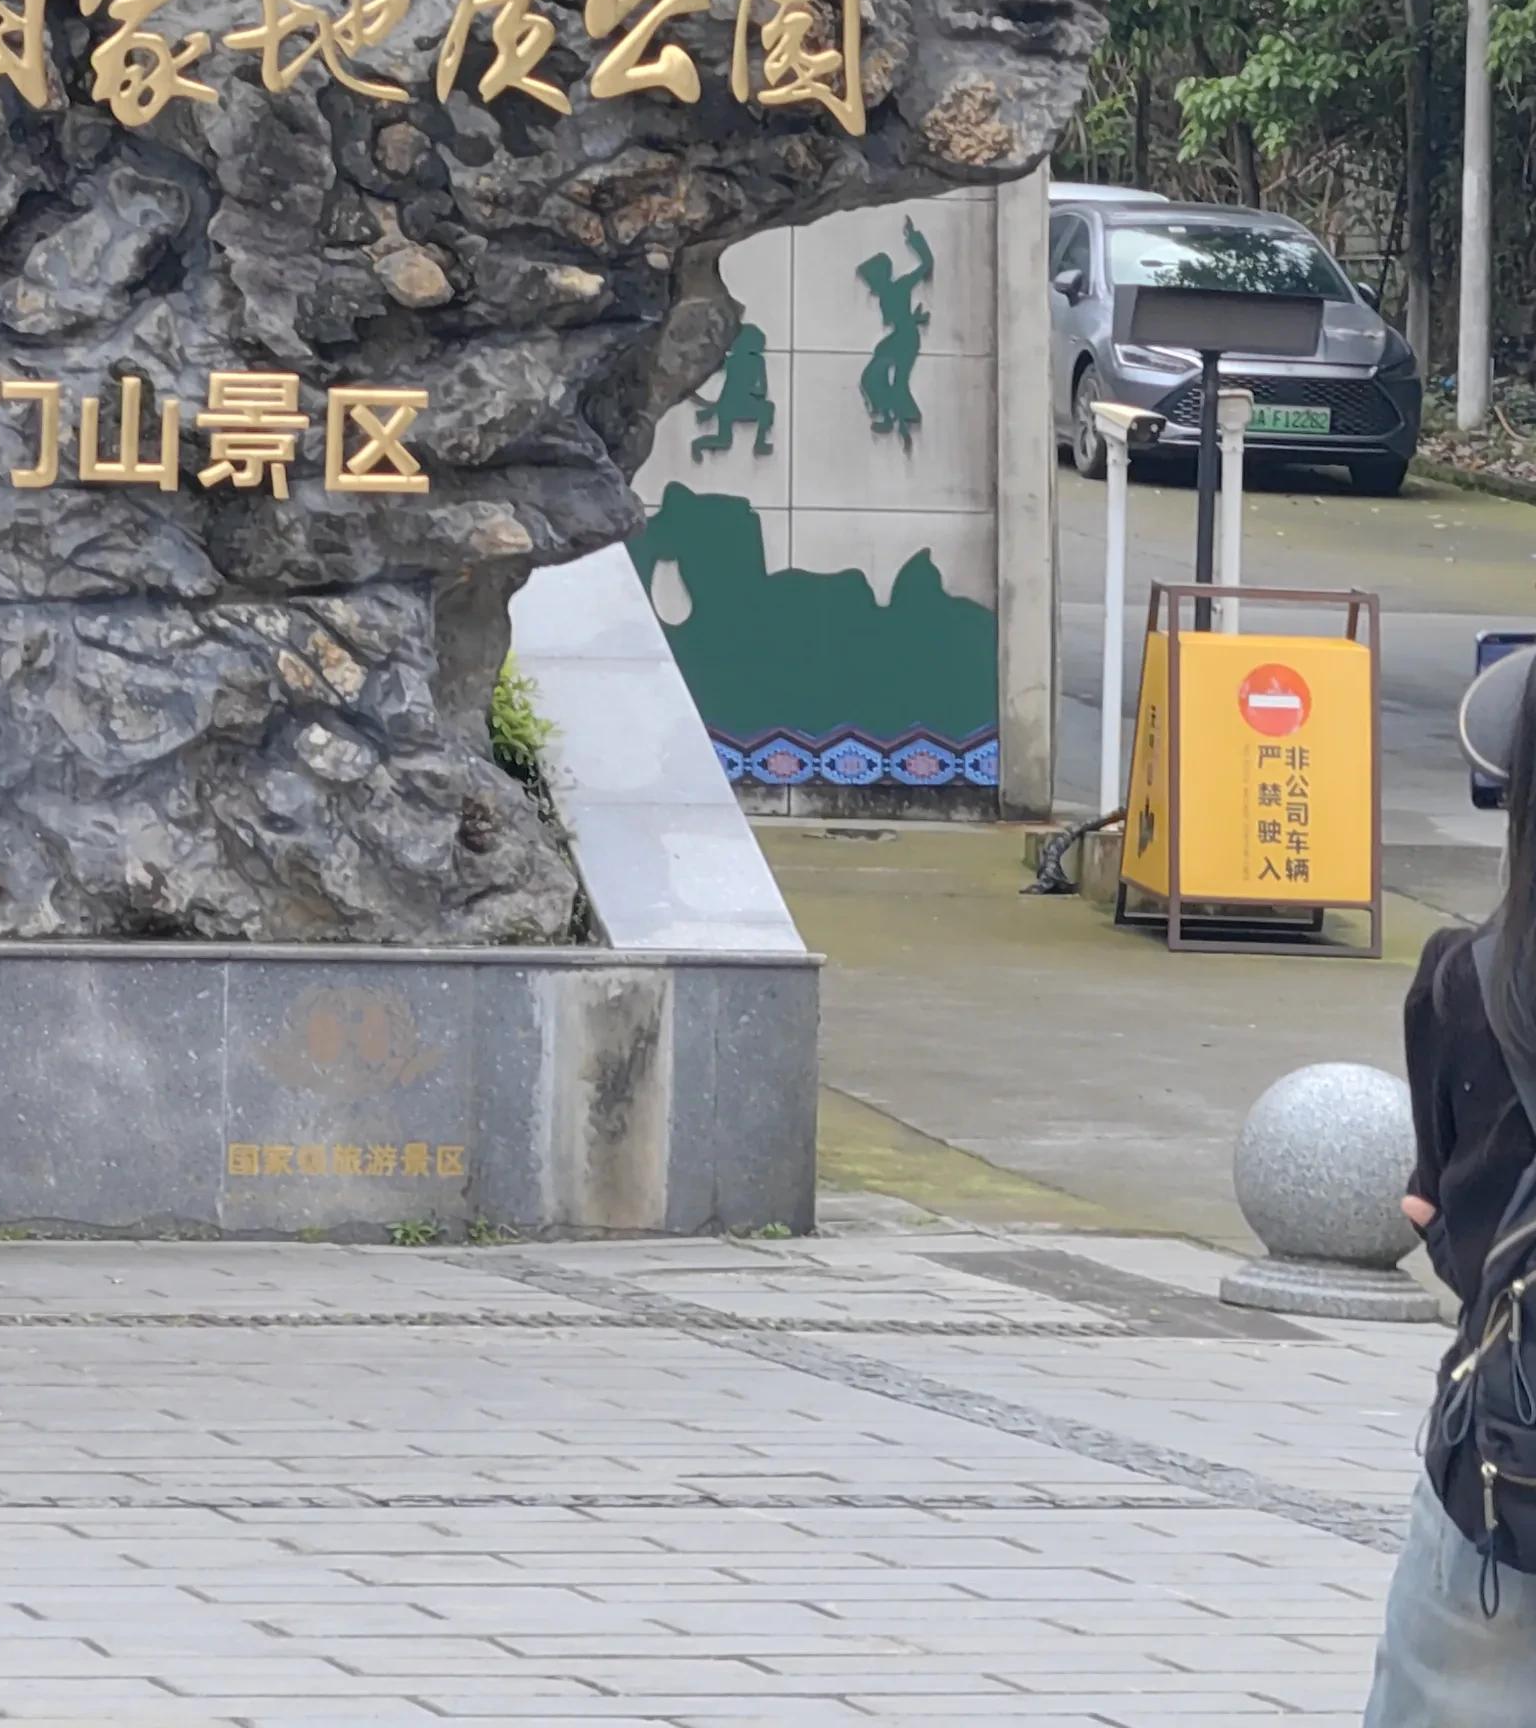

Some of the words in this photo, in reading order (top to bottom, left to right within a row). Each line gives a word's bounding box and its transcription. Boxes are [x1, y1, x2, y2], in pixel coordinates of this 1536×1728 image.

[1257, 744, 1282, 881] 严禁驶入
[1284, 745, 1310, 883] 非公司车辆
